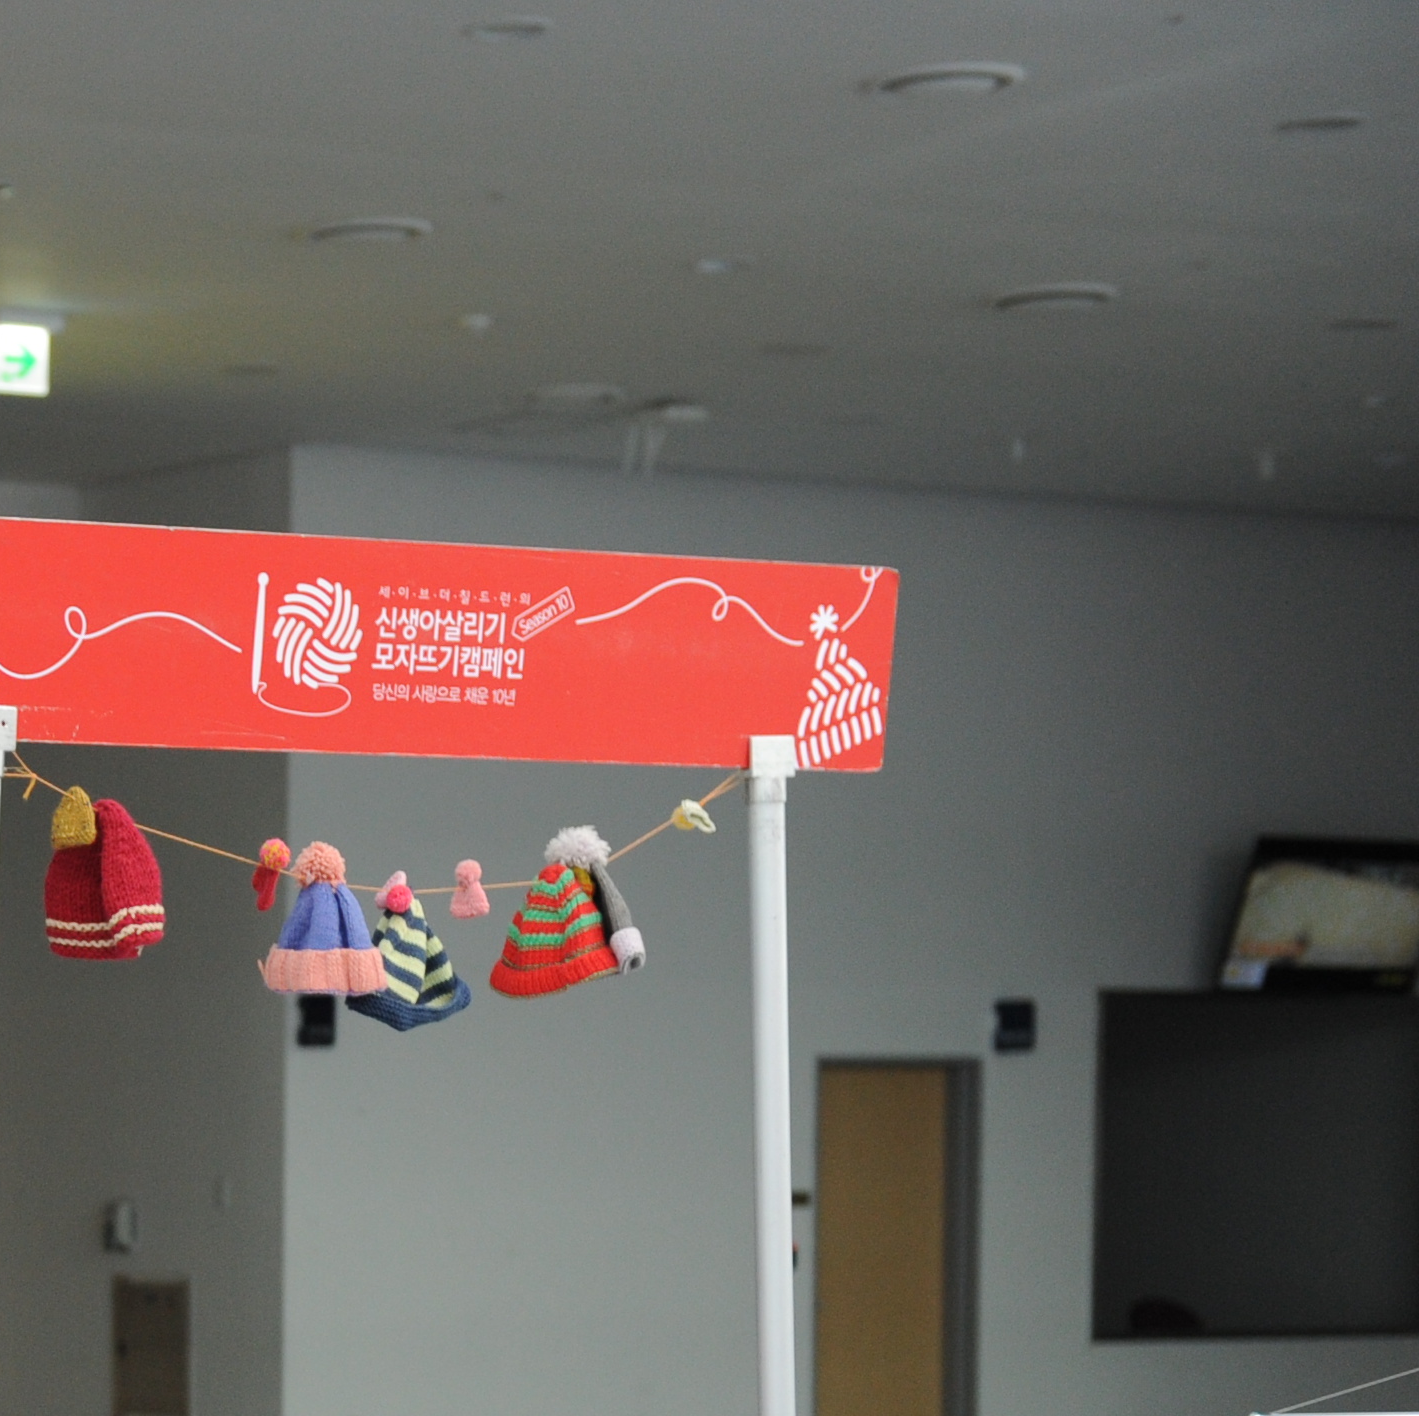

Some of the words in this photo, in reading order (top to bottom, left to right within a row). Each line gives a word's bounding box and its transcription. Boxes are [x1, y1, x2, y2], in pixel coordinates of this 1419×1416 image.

[375, 607, 507, 645] 신생아살리기
[518, 603, 557, 635] Season
[555, 594, 569, 611] 10
[371, 643, 525, 680] 모자뜨기캠페인
[372, 683, 410, 702] 당신의
[412, 684, 462, 704] 사랑으로
[464, 686, 489, 706] 채운
[492, 688, 516, 707] 10년
